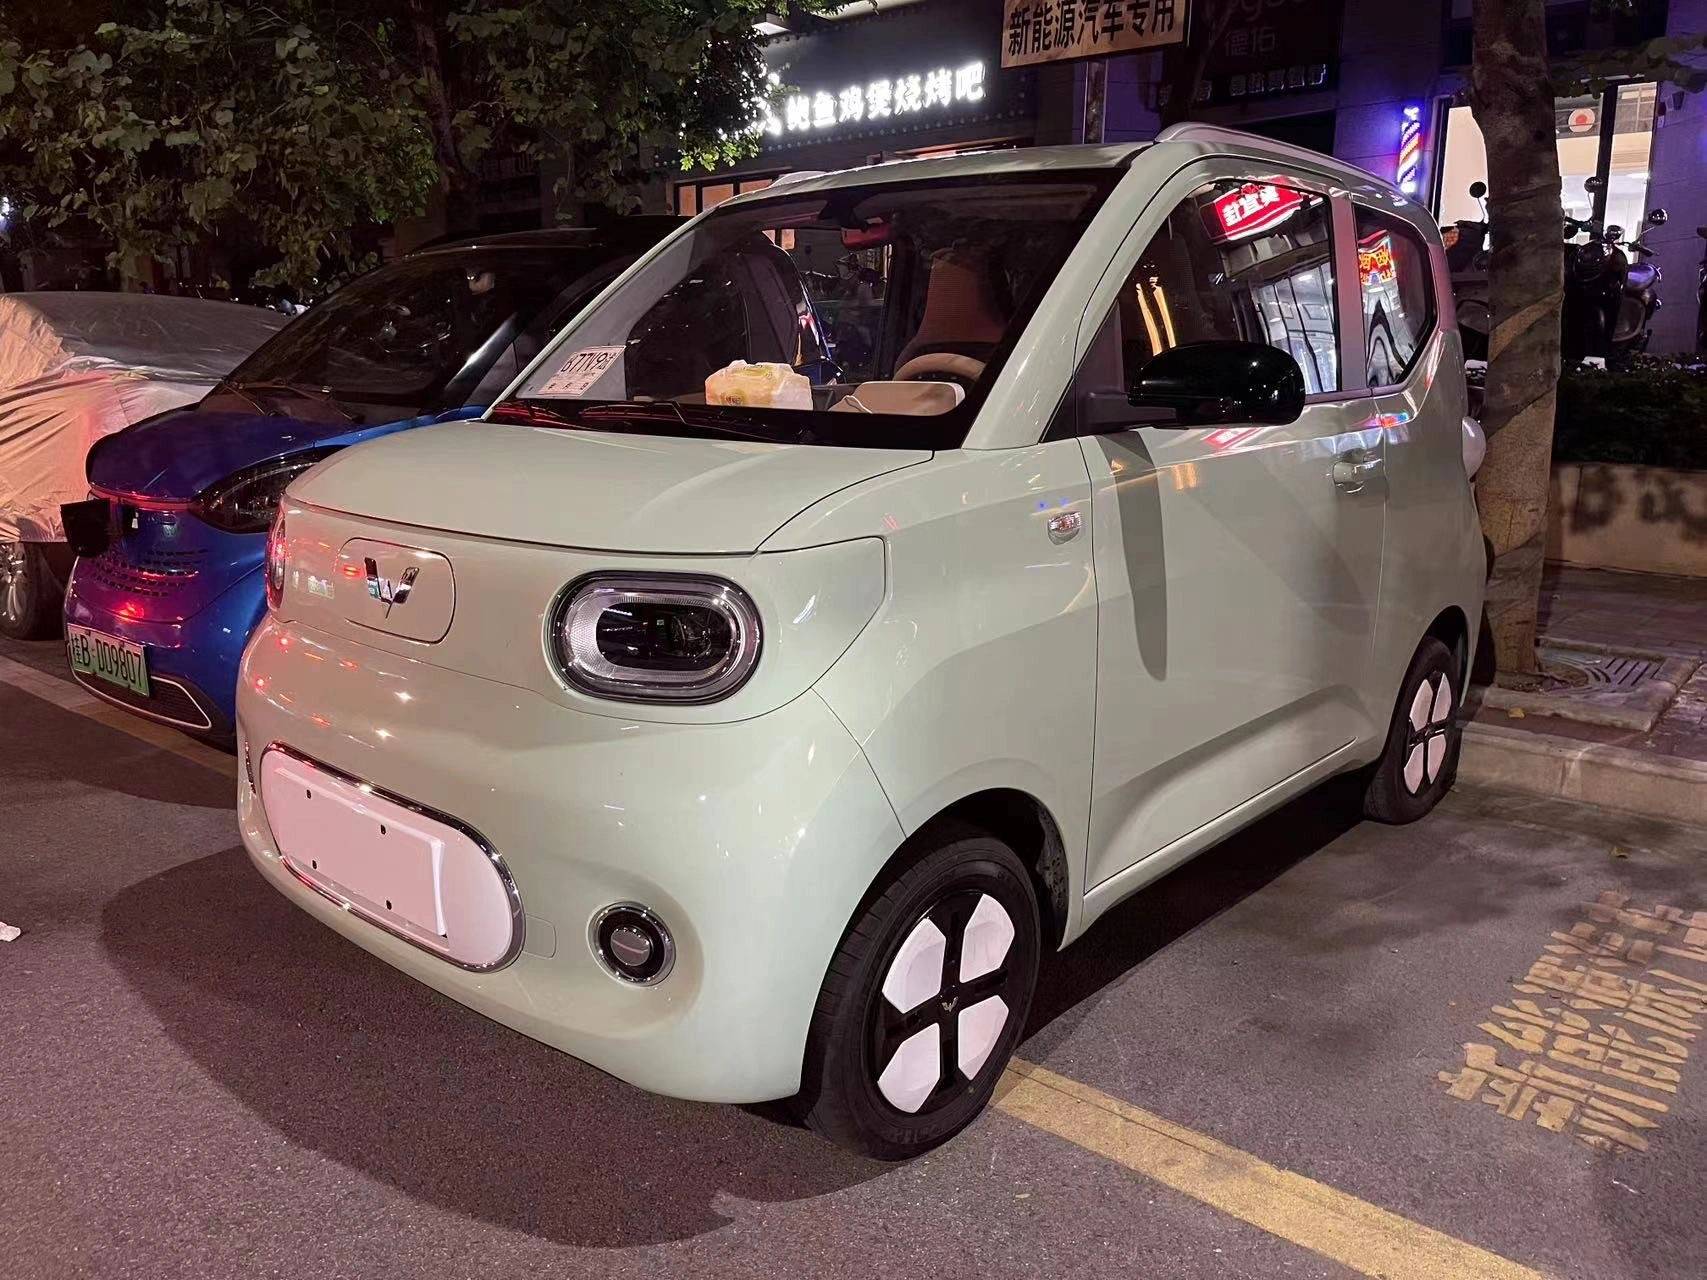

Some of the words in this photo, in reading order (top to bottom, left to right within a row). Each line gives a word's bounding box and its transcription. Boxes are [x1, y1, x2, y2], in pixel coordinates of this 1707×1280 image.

[1008, 0, 1175, 56] 新能源汽车专用
